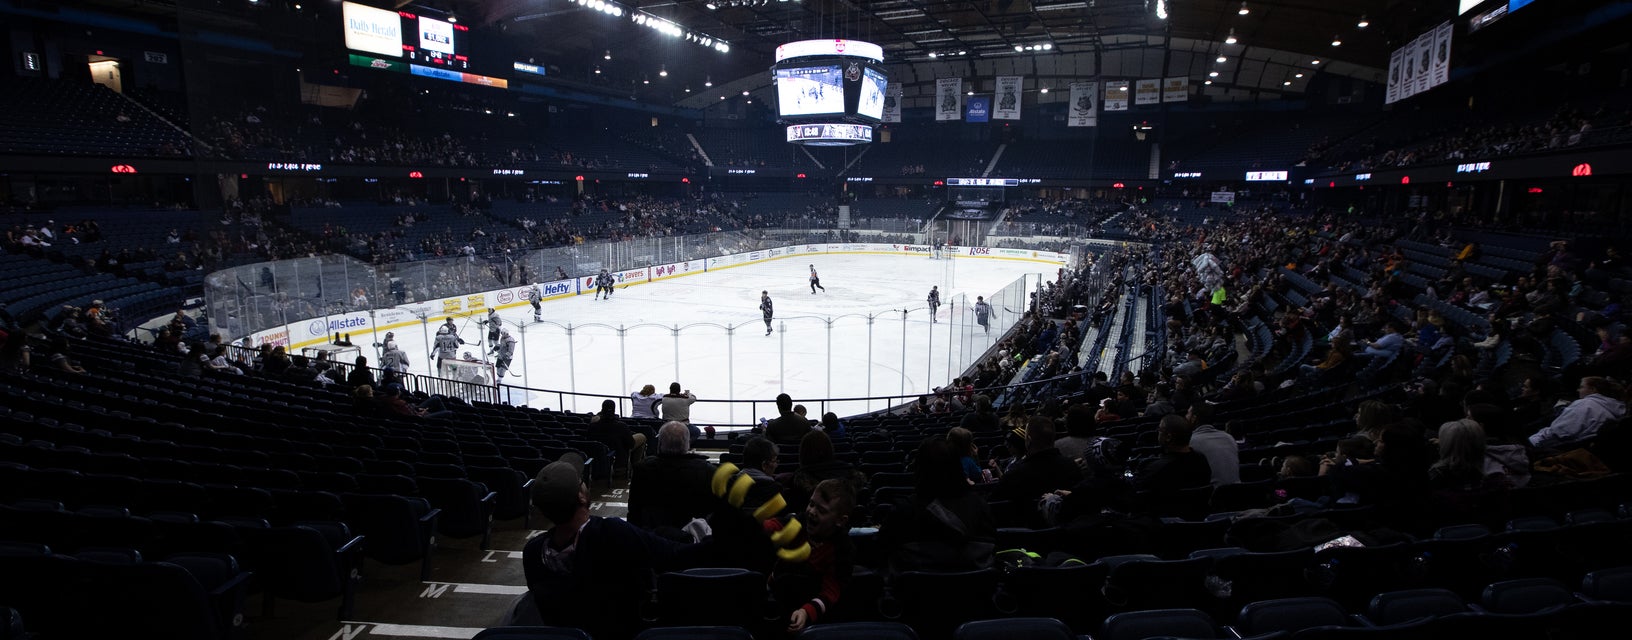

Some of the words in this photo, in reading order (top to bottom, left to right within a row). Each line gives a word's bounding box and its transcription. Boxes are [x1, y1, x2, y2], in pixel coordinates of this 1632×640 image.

[350, 18, 369, 32] Daily
[371, 22, 396, 37] Herald
[969, 247, 990, 255] ROSE
[544, 284, 569, 295] Hefty
[328, 316, 366, 331] Allstate
[443, 343, 451, 351] 14
[589, 502, 603, 510] H
[481, 550, 497, 562] L
[420, 584, 449, 598] M
[328, 624, 366, 640] N
